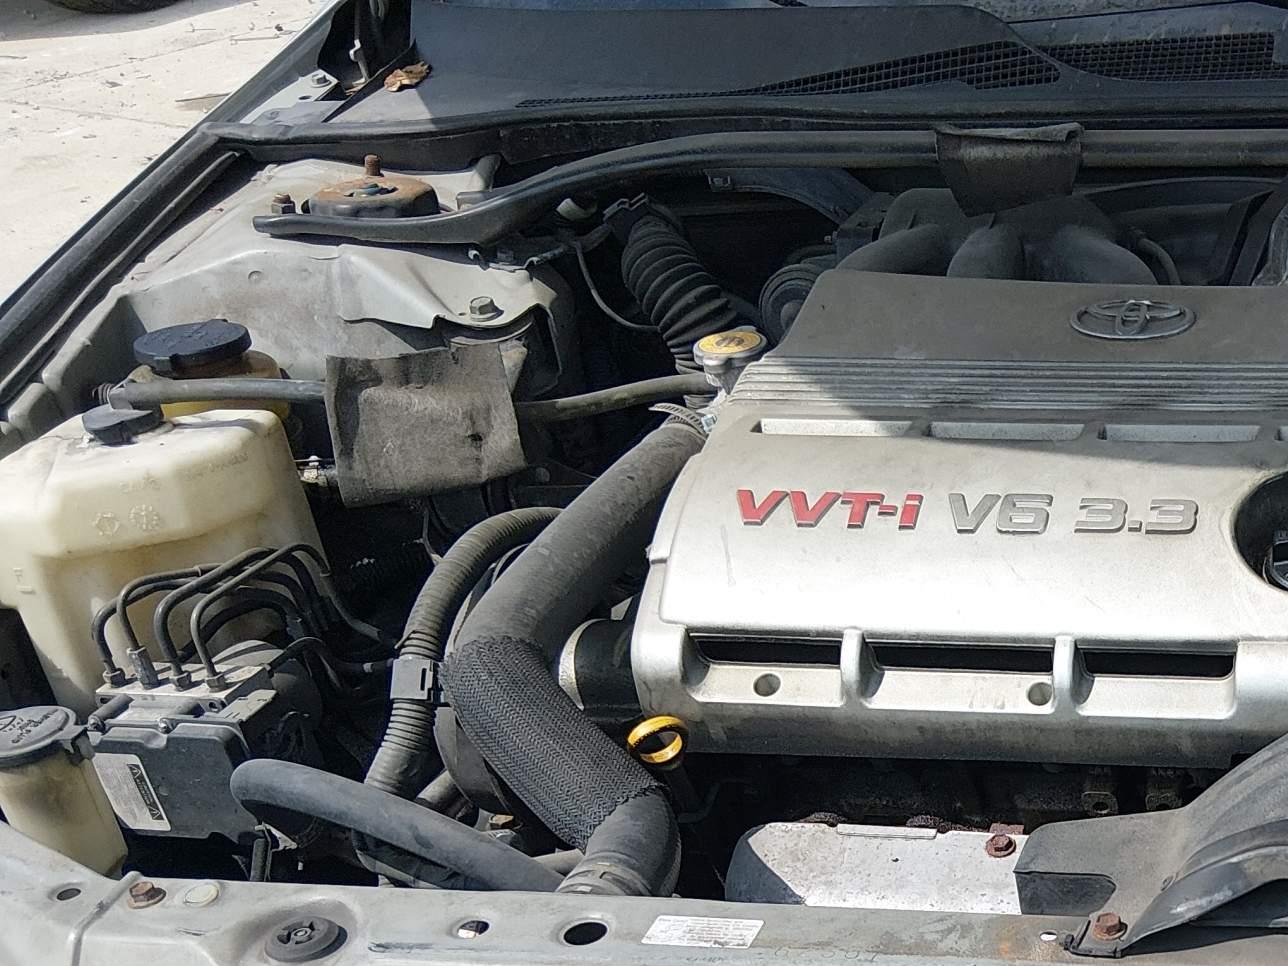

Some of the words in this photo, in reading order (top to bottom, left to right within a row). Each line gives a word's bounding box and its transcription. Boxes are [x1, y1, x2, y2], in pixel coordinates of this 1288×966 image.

[736, 489, 925, 531] VVT-i
[948, 492, 1054, 534] V6
[1073, 497, 1200, 535] 3.3
